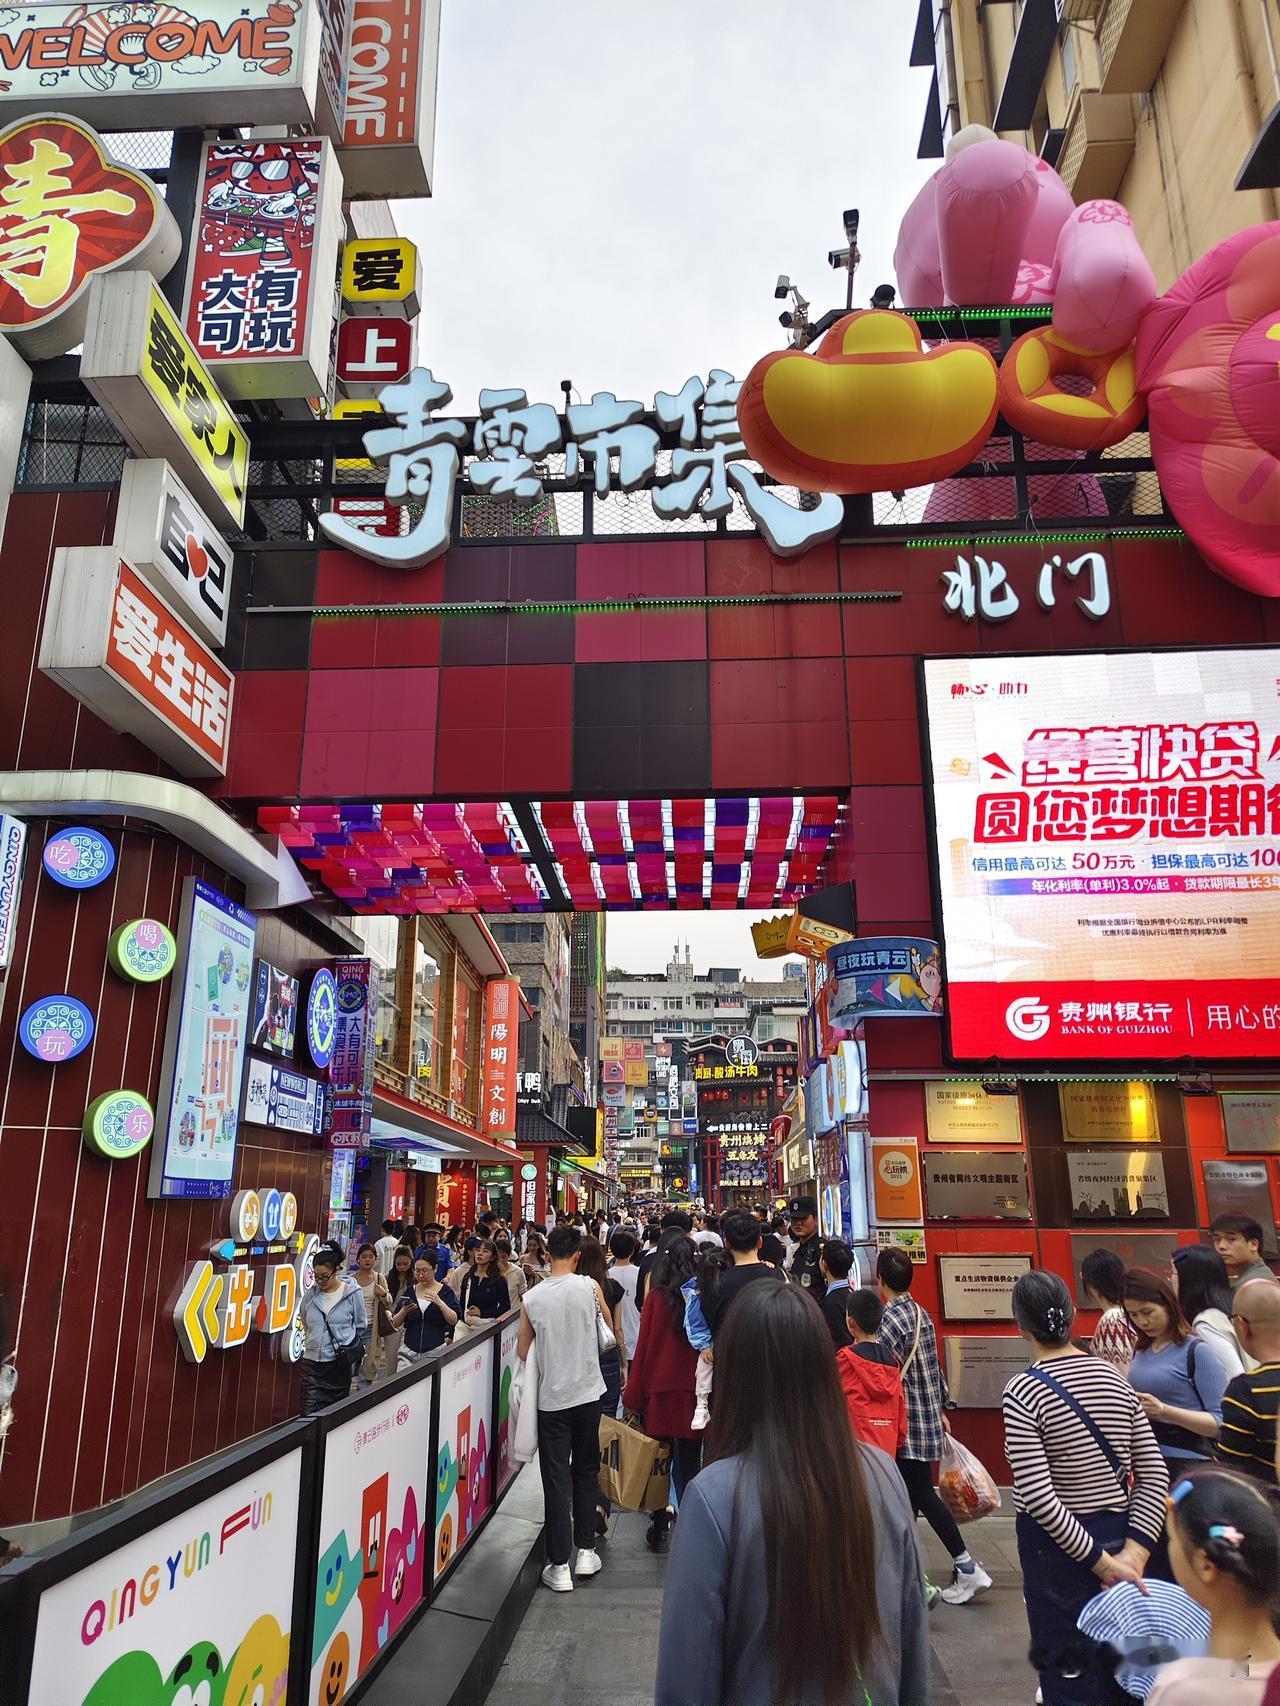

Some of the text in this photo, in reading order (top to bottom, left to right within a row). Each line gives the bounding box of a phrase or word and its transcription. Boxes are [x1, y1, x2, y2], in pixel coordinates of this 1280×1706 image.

[353, 248, 403, 291] 爱
[202, 266, 302, 310] 大有
[198, 306, 299, 354] 可玩
[346, 329, 396, 372] 上
[941, 552, 1111, 619] 北门
[112, 583, 229, 748] 爱生活
[49, 845, 72, 865] 吃
[139, 924, 158, 944] 喝
[1058, 1001, 1173, 1023] 贵州银行
[1061, 1024, 1173, 1034] BANK OF GUIZHOU
[43, 1035, 66, 1056] 玩
[129, 1114, 148, 1134] 乐
[718, 1132, 767, 1148] 贵州烧烤
[221, 1262, 297, 1350] 出口
